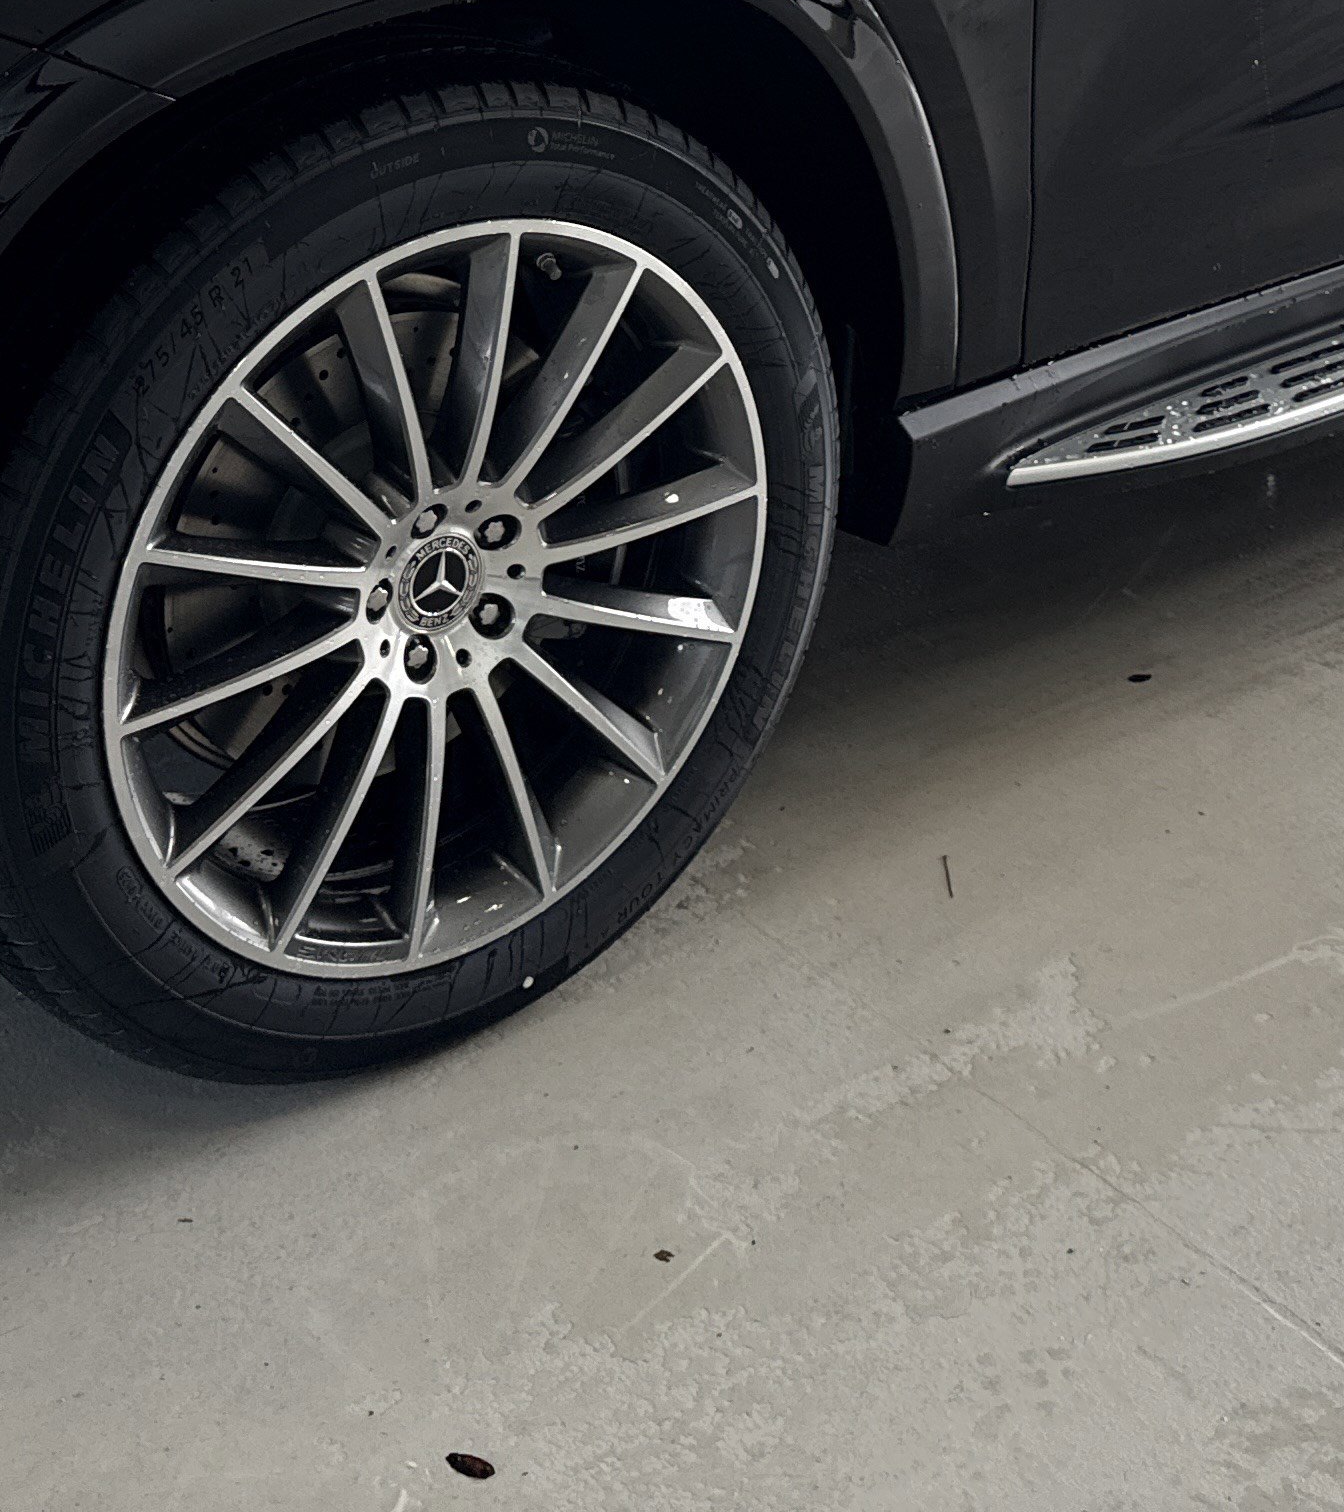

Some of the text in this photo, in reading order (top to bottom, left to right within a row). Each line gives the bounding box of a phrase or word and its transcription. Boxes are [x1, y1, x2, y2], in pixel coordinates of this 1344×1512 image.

[416, 537, 471, 561] MERCEDES
[19, 431, 121, 763] MICHELIN
[419, 613, 450, 627] BENZ
